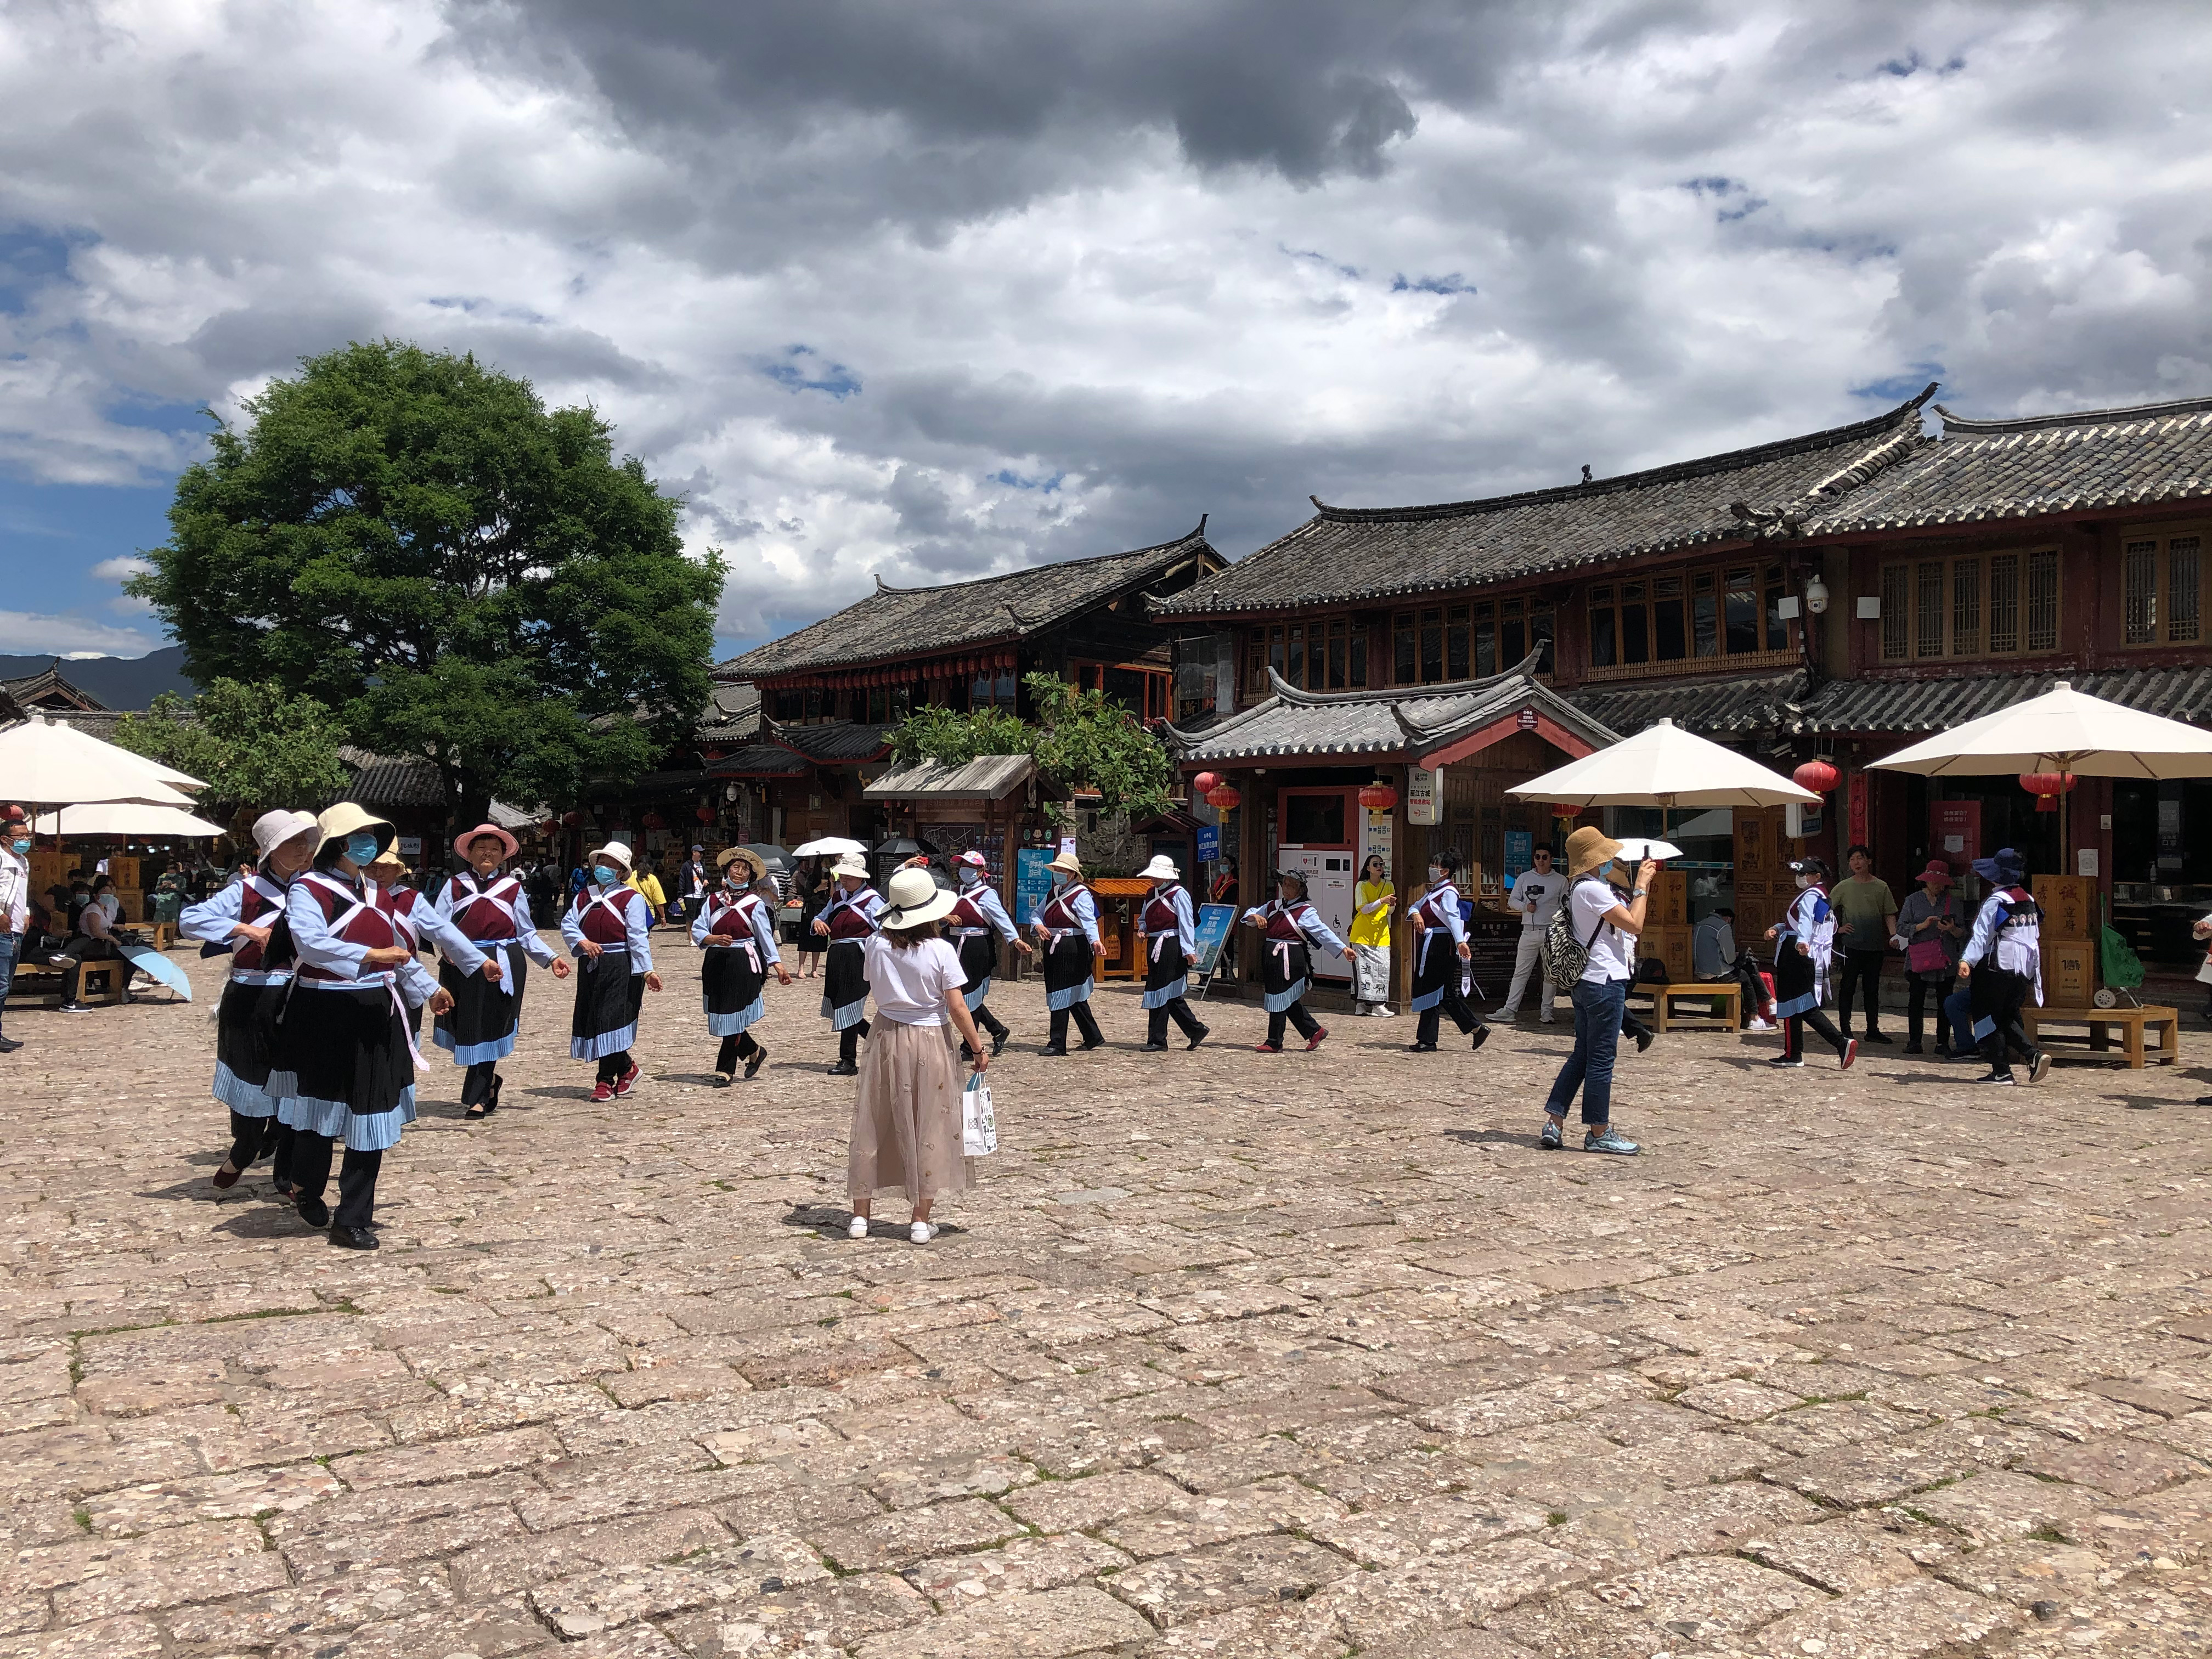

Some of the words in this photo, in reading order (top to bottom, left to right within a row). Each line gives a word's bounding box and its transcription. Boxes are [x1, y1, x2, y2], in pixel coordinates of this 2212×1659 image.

[1024, 860, 1044, 869] 一部手机
[1028, 868, 1042, 877] 游云南
